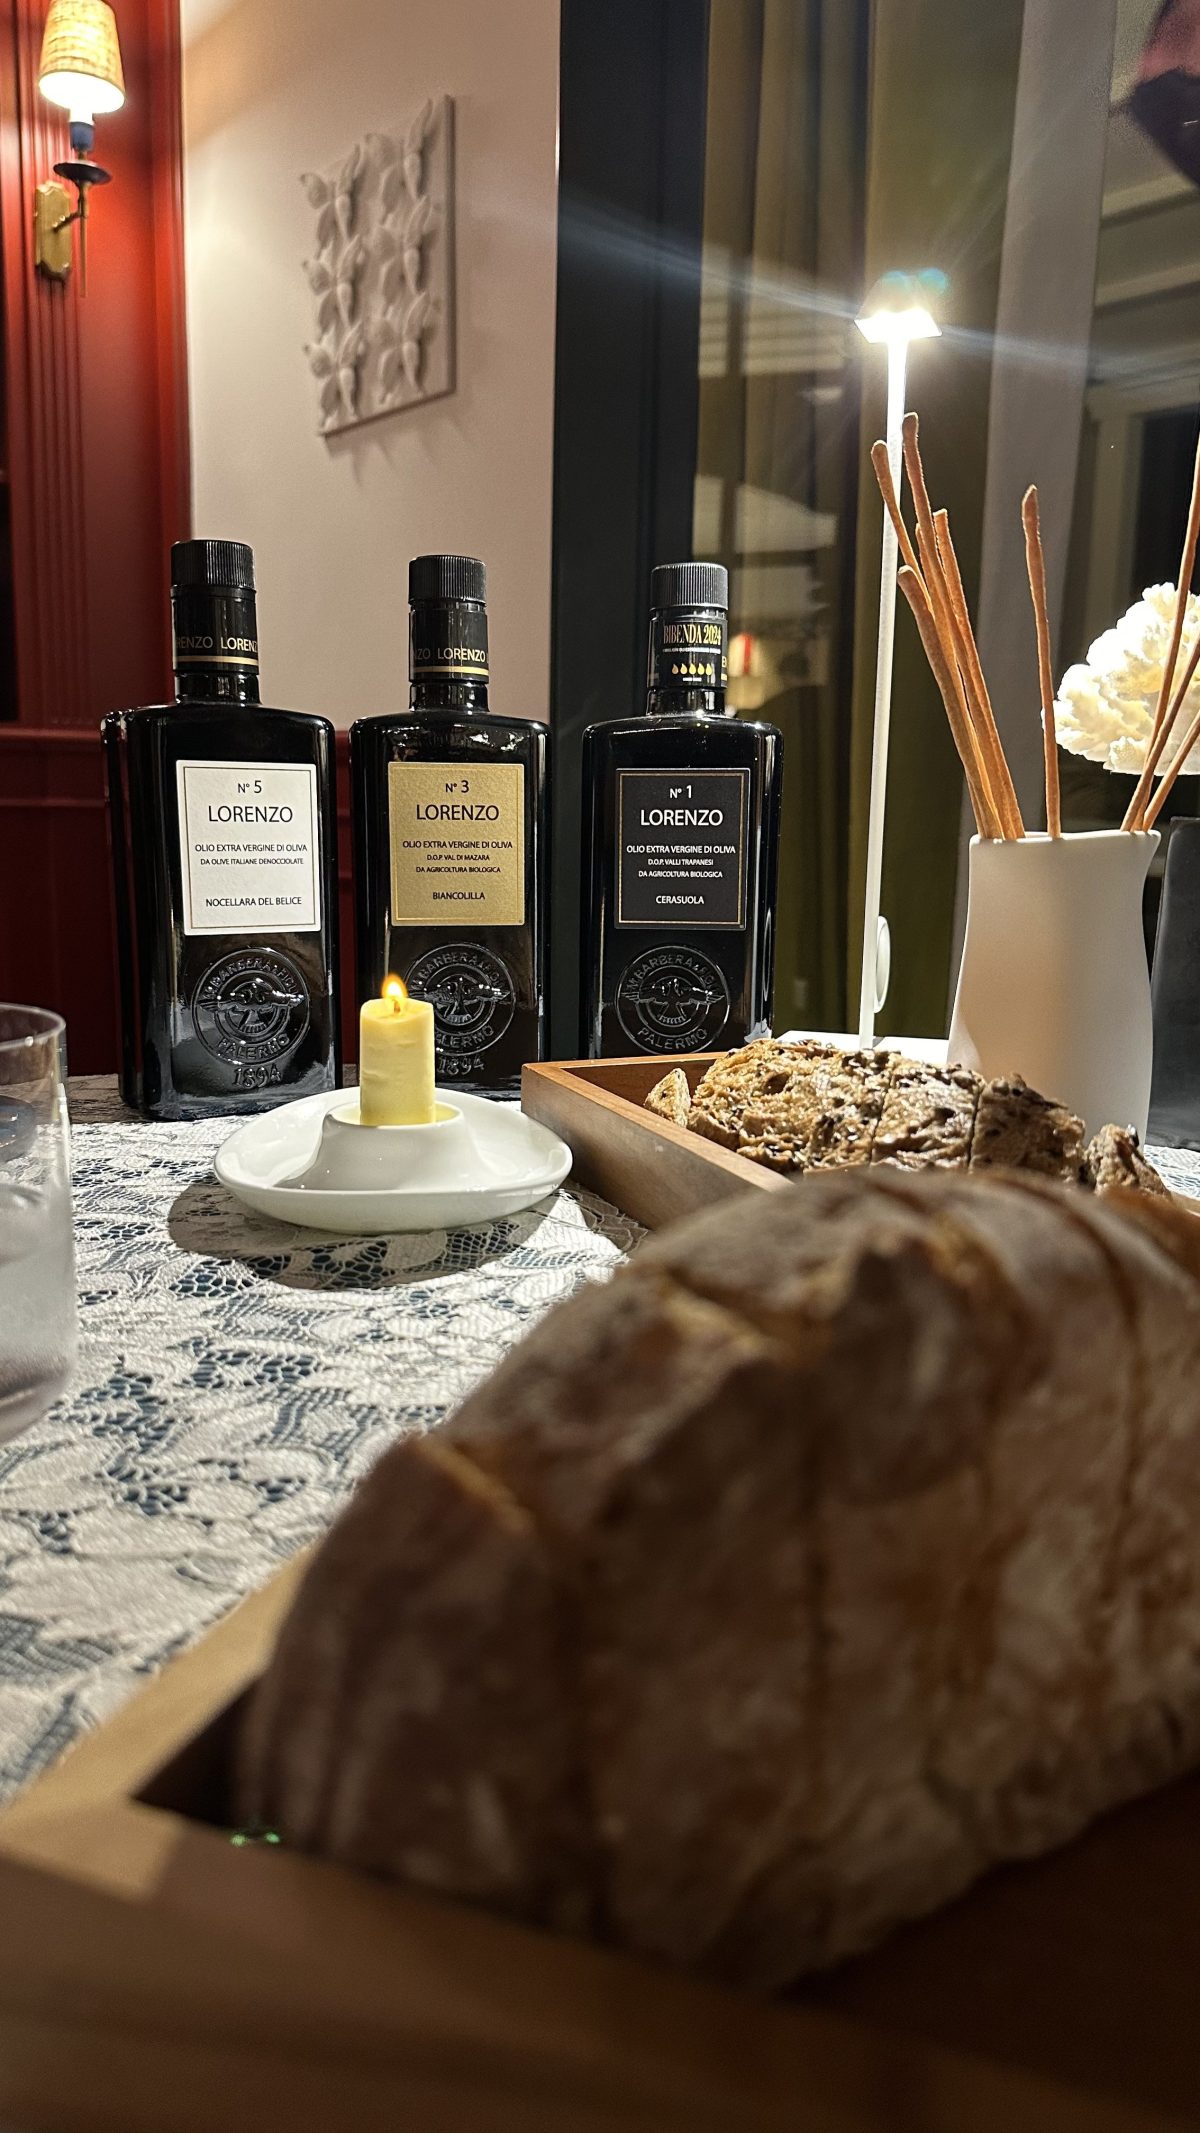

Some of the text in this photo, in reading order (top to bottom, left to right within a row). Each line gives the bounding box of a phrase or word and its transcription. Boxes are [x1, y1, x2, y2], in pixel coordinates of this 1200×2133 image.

[663, 623, 722, 646] BIBENDA 2024
[437, 647, 486, 662] LORENZO
[253, 780, 262, 793] 5
[461, 780, 470, 793] 3
[686, 784, 692, 799] 1
[208, 805, 293, 823] LORENZO
[416, 804, 499, 820] LORENZO
[640, 809, 723, 826] LORENZO
[194, 844, 308, 852] OLIO EXTRA VERGINE DI OLIVA
[402, 840, 513, 849] OLIO EXTRA VERGINE DI OLIVA
[626, 845, 736, 854] OLIO EXTRA VERGINE DI OLIVA
[648, 870, 689, 878] AGRICOLTURA
[205, 896, 302, 907] NOCELLARA DEL BELICE
[432, 892, 485, 900] BIANCOLILLA
[655, 895, 705, 904] CERASUOLA
[218, 1033, 290, 1059] PALERMO
[637, 1028, 707, 1049] PALERMO
[437, 1055, 485, 1075] 1894
[232, 1063, 282, 1088] 1894
